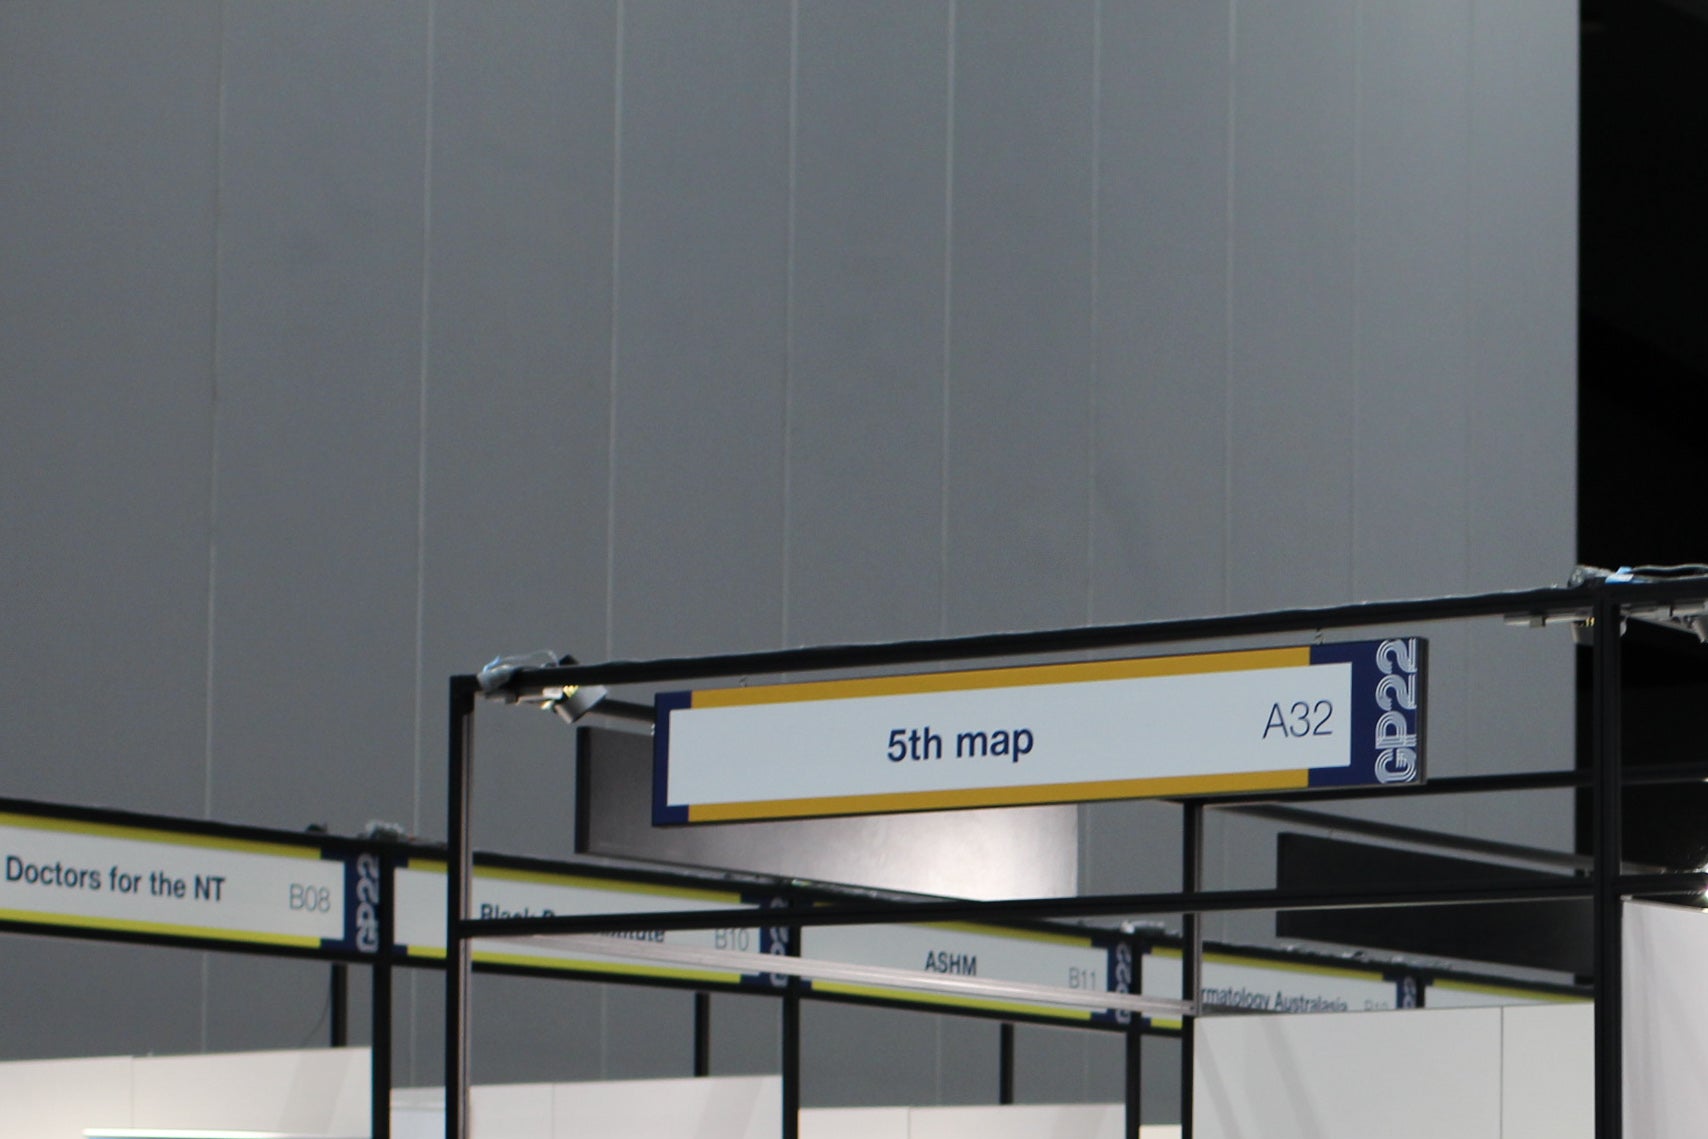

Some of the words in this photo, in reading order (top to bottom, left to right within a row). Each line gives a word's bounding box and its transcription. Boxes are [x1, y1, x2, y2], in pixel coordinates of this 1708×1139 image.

[887, 726, 943, 763] 5th
[955, 726, 1035, 765] map
[1262, 699, 1334, 741] A32
[1375, 638, 1417, 785] GP22
[5, 855, 102, 890] Doctors
[109, 865, 141, 894] for
[149, 871, 187, 899] the
[194, 876, 226, 902] NT
[288, 882, 332, 914] B08
[356, 852, 380, 953] GP22
[924, 949, 978, 977] ASHM
[1068, 966, 1098, 991] B11
[1200, 986, 1271, 1010] rmatology
